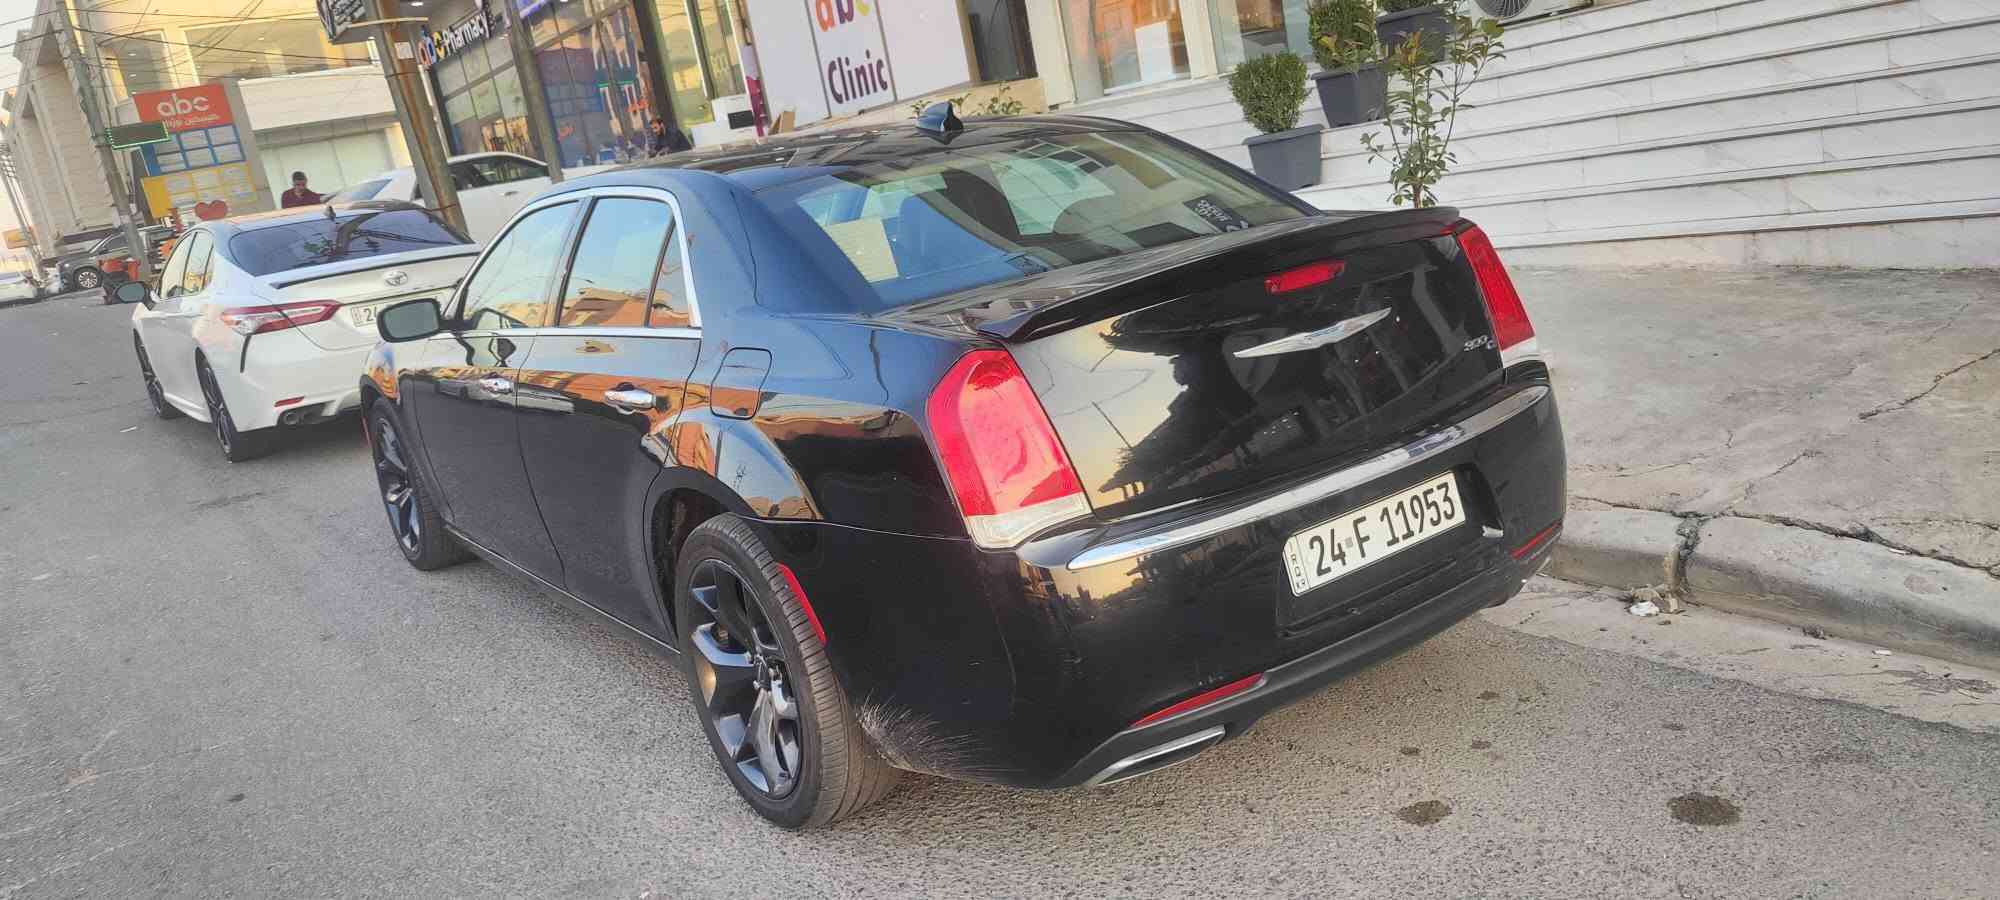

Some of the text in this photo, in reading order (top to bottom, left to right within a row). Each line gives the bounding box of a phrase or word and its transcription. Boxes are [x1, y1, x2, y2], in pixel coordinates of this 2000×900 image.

[828, 49, 888, 104] Clinic
[157, 93, 209, 117] abc
[1309, 481, 1456, 577] 24 F 11953
